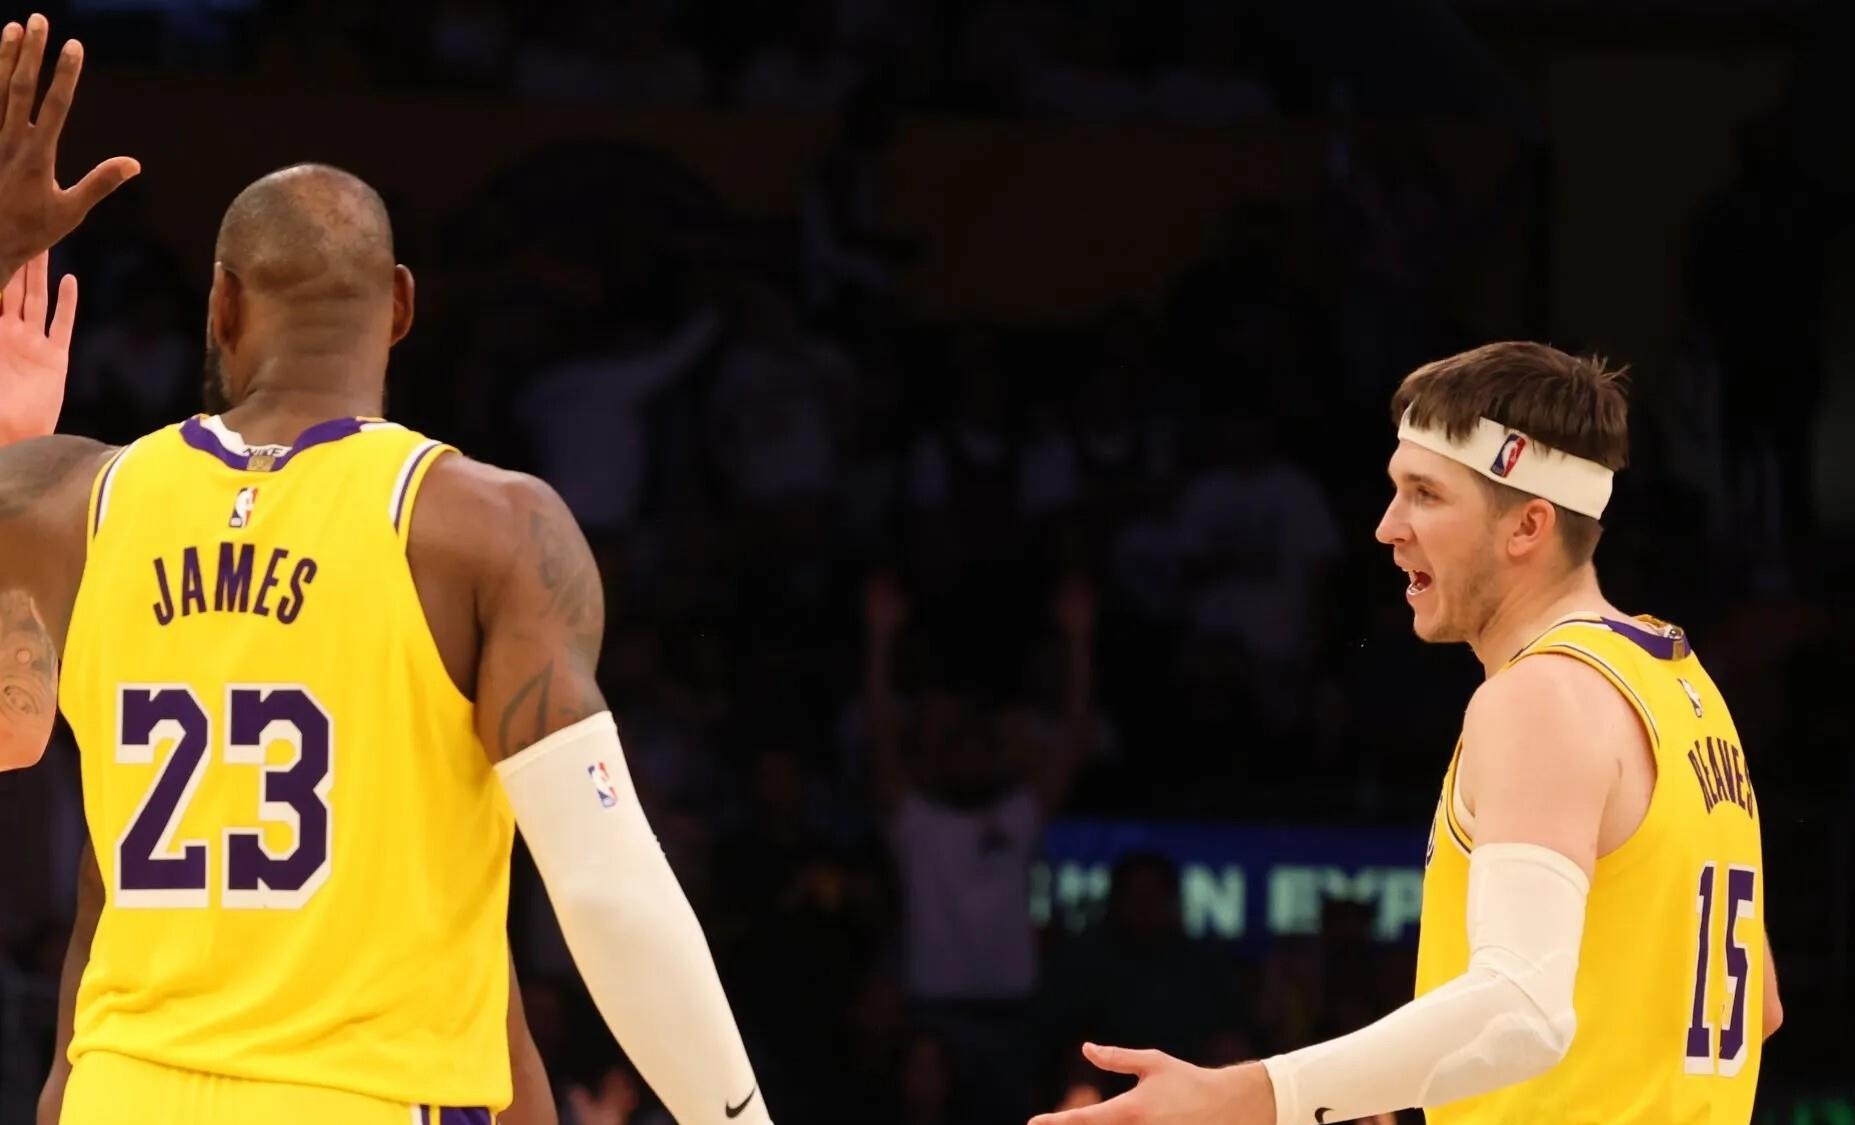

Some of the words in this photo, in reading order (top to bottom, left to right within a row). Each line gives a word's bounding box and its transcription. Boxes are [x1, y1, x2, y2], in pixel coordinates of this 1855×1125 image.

[151, 541, 318, 626] JAMES
[114, 681, 335, 910] 23
[1682, 859, 1757, 1078] 15
